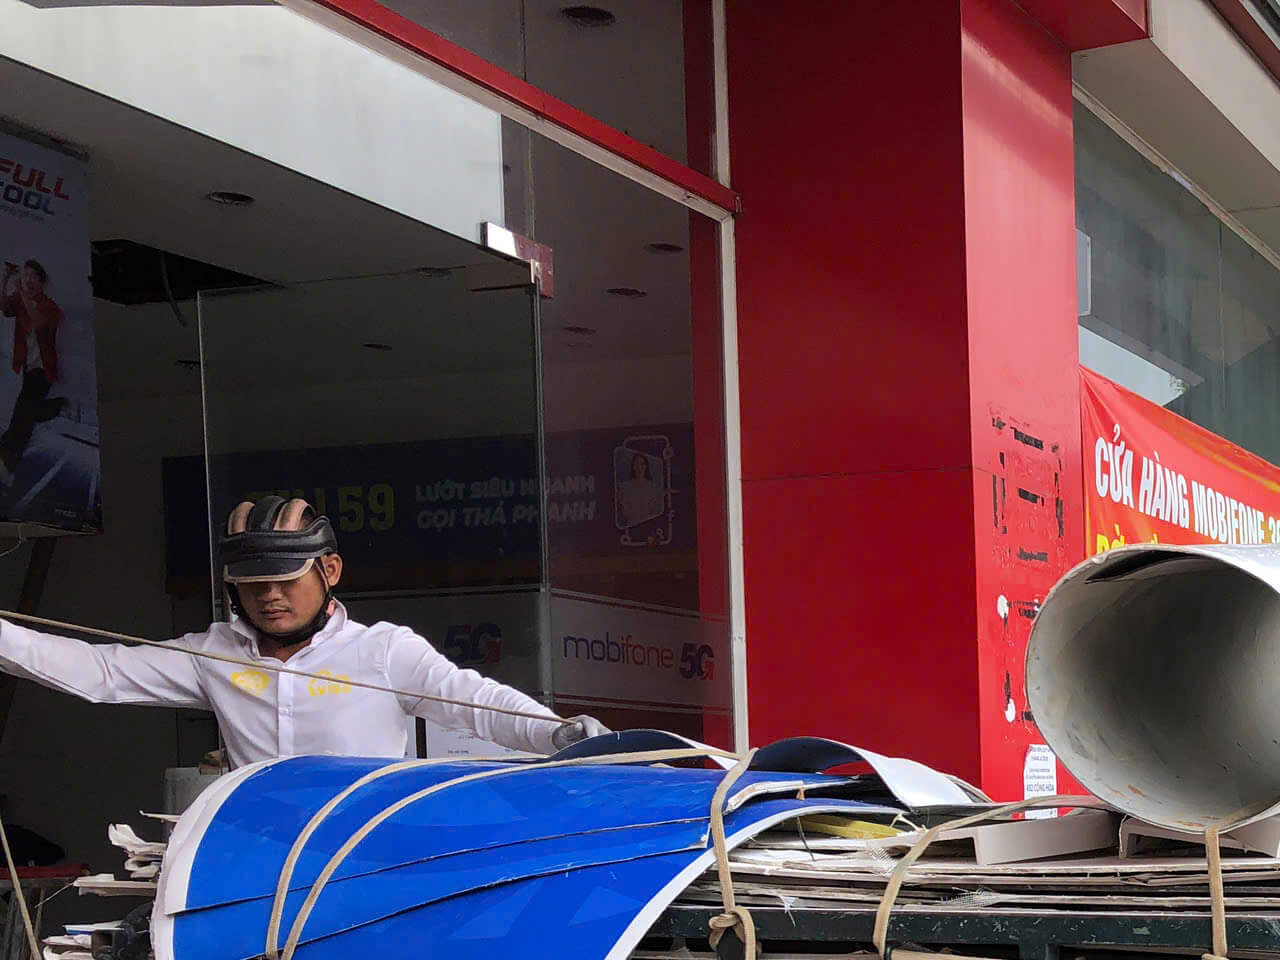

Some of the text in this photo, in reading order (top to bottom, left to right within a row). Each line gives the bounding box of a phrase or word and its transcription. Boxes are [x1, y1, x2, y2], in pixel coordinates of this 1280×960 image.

[0, 181, 55, 216] OOL
[1095, 423, 1134, 508] CỬA
[1138, 451, 1190, 529] HÀNG
[1191, 480, 1264, 545] MOBIFONE
[562, 631, 714, 681] mobifone 5G
